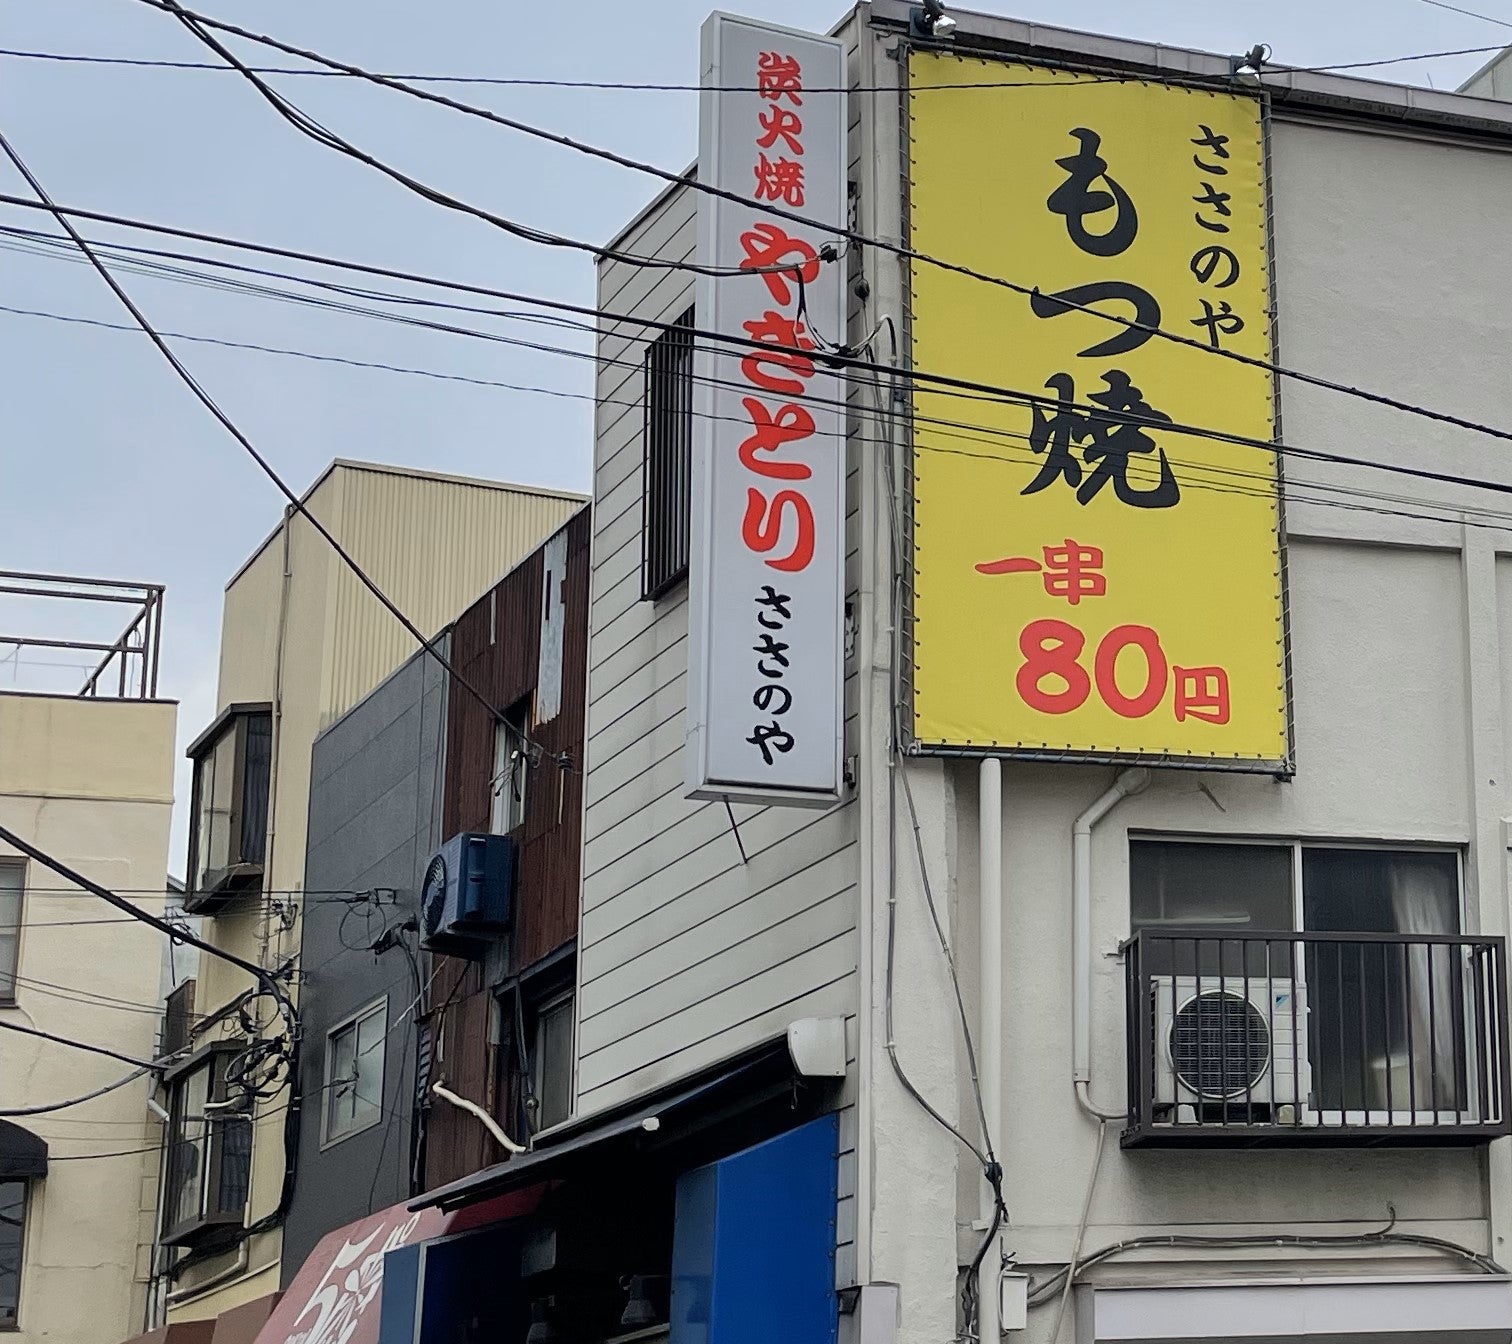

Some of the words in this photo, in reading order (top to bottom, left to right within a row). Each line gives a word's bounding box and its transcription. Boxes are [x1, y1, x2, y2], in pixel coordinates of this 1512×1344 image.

[754, 51, 804, 207] 炭火焼
[1020, 127, 1181, 508] もつ焼
[1190, 124, 1245, 348] ささのや
[739, 223, 816, 572] やきとり
[974, 538, 1106, 605] 一串
[746, 585, 796, 765] ささのや
[1016, 619, 1231, 725] 80円
